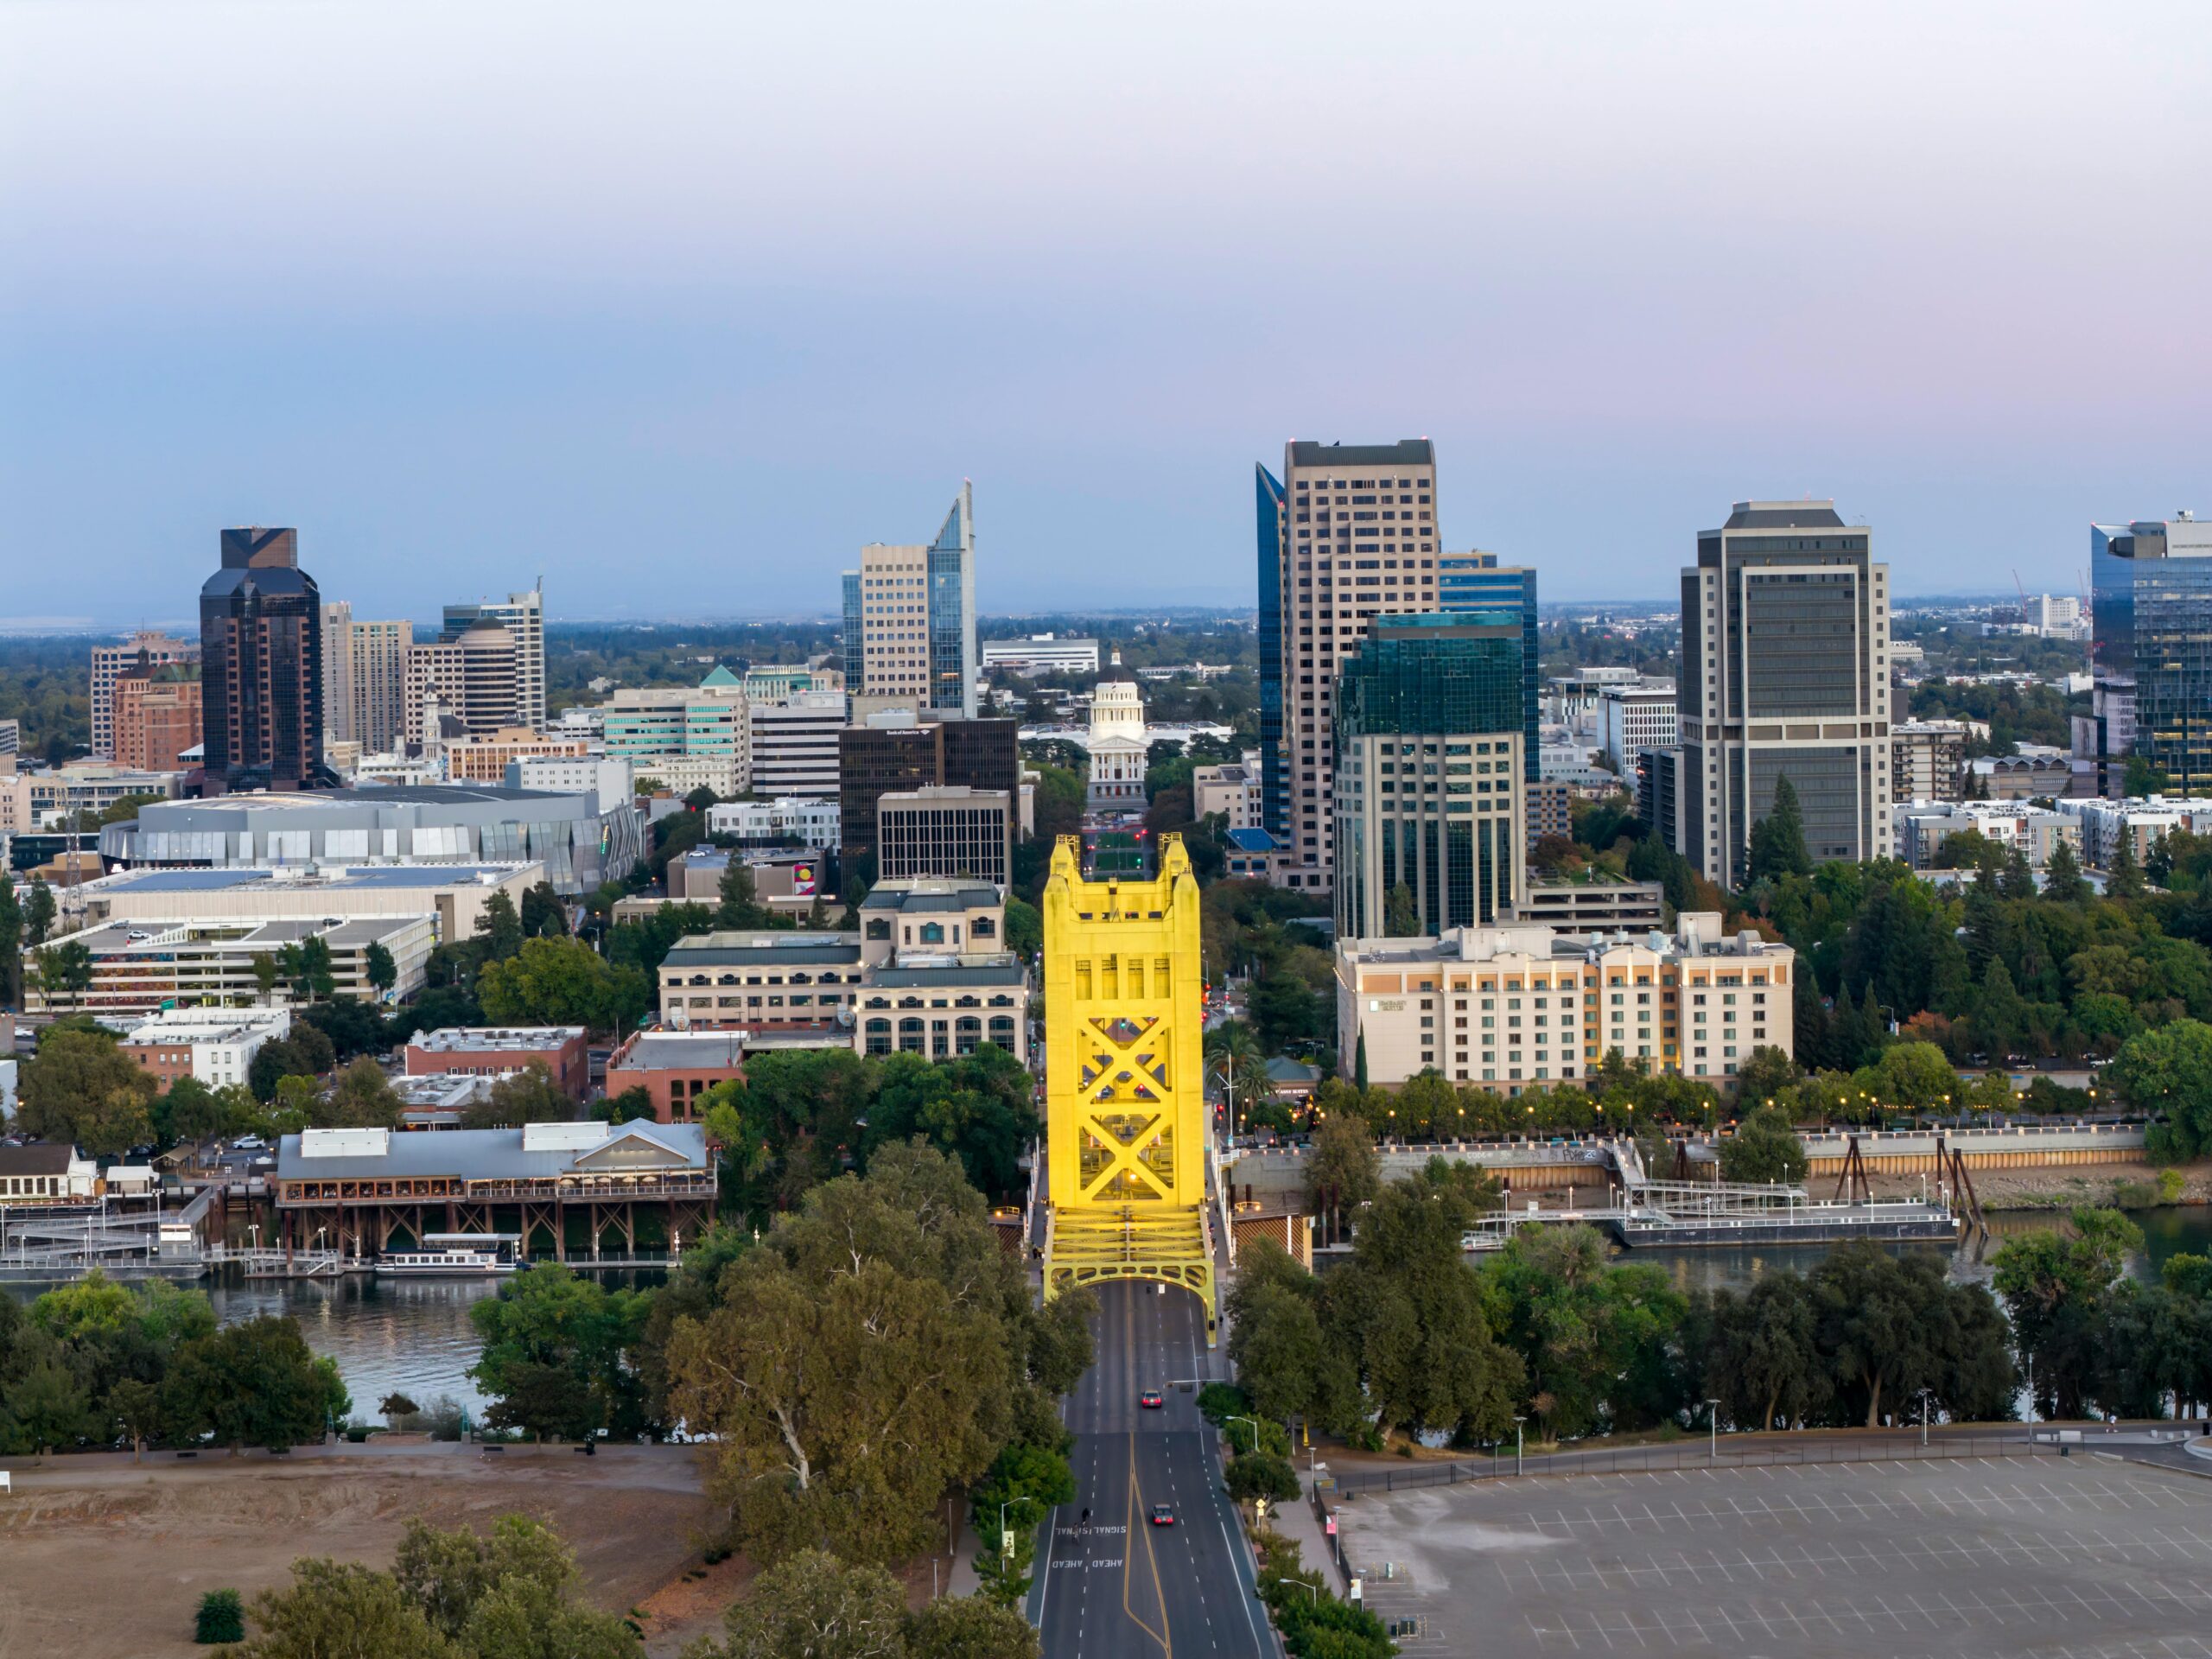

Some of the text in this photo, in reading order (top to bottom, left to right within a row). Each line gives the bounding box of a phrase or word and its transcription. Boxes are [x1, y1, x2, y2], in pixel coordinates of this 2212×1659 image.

[1056, 1527, 1089, 1535] SINAL
[1052, 1560, 1083, 1568] AHEAD
[1092, 1559, 1123, 1567] AHEAD
